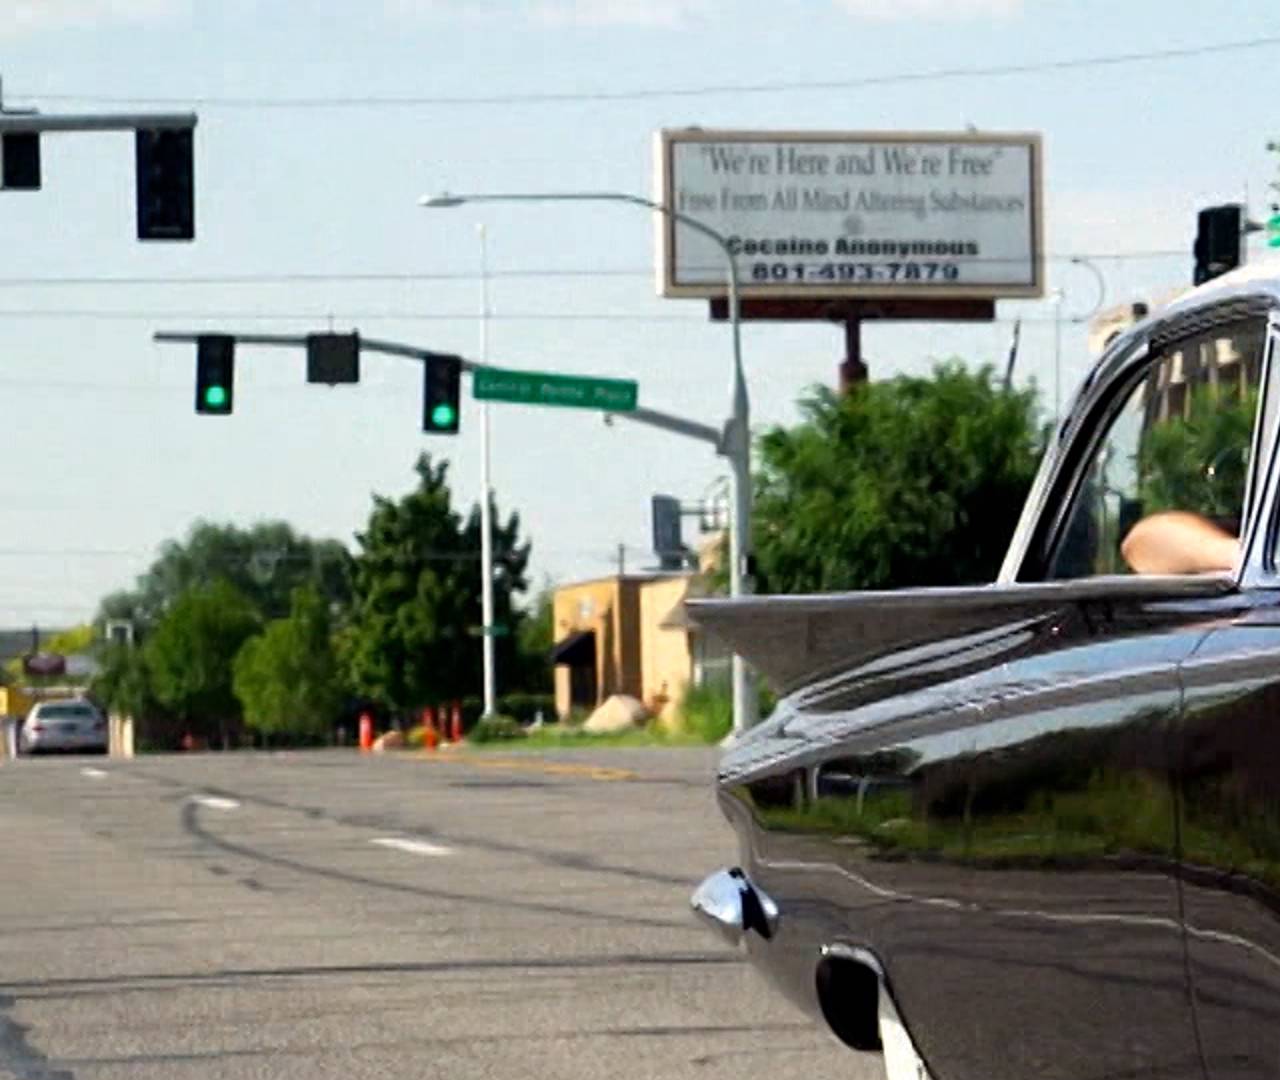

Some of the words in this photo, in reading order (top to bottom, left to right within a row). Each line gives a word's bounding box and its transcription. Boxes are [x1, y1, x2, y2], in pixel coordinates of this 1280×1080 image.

[776, 147, 829, 175] Here
[835, 147, 875, 175] and
[772, 187, 798, 211] All
[728, 235, 829, 256] Cocaine
[834, 237, 980, 259] Anonymous
